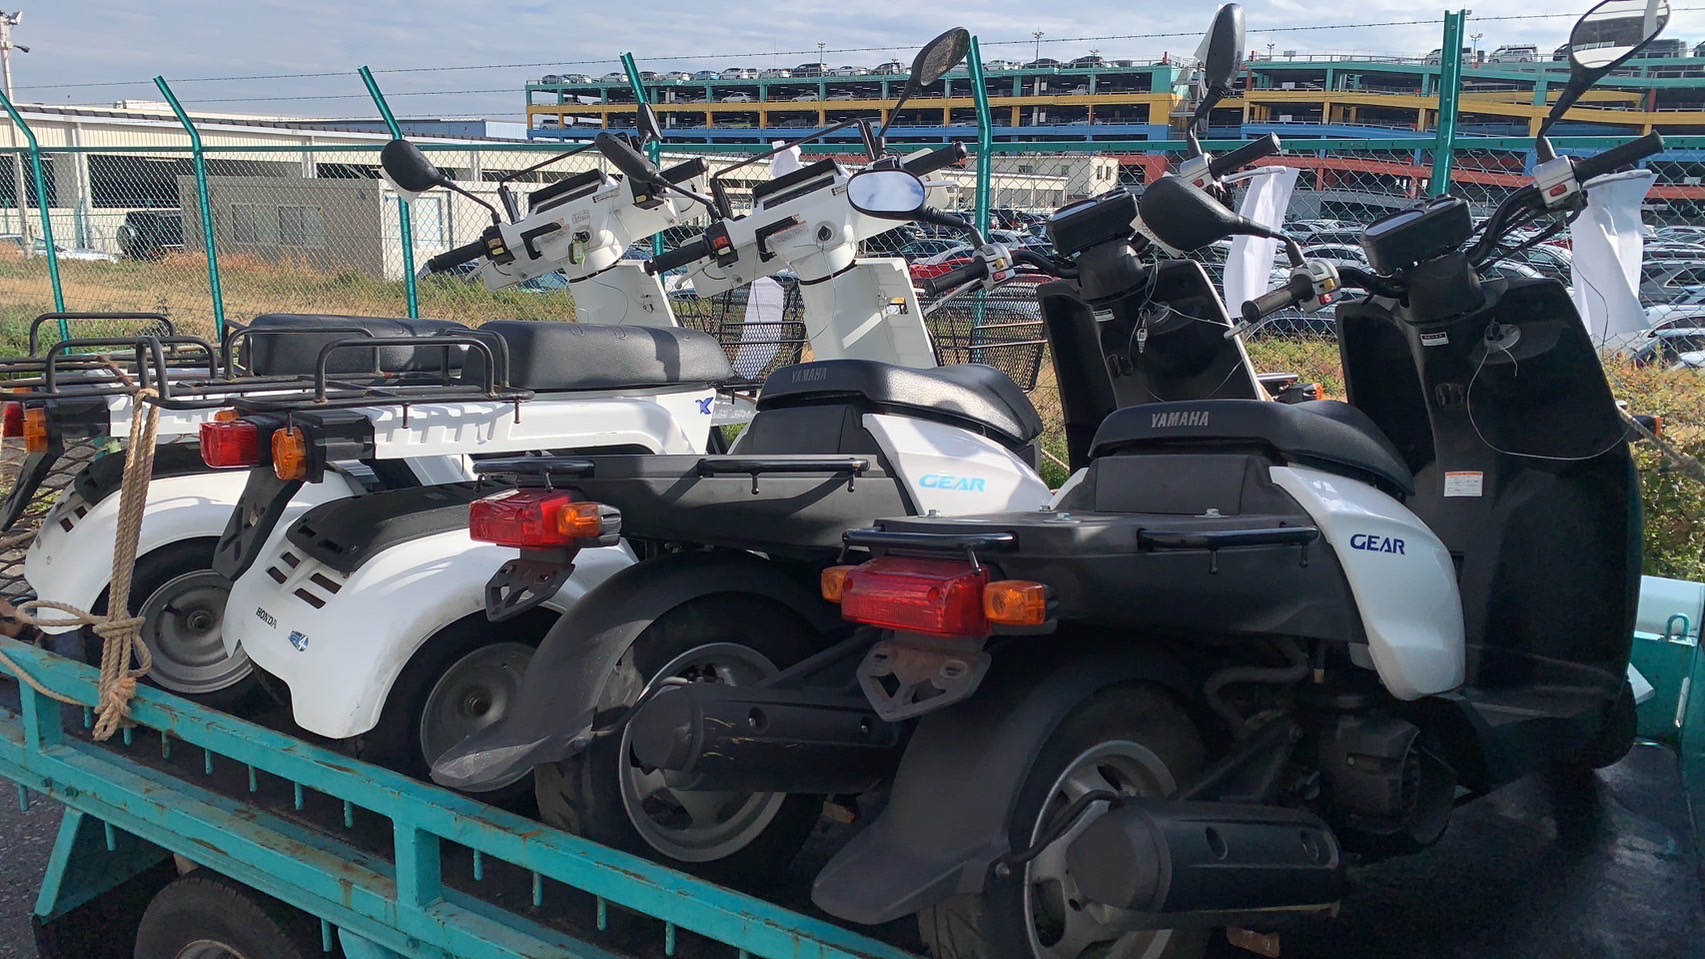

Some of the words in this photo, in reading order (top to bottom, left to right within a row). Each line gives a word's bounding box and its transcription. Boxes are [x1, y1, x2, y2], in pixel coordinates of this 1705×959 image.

[791, 367, 827, 383] YAMAHA
[1151, 411, 1209, 428] YAMAHA
[919, 474, 986, 492] GEAR
[1350, 533, 1405, 555] GEAR
[255, 606, 278, 630] HONDA
